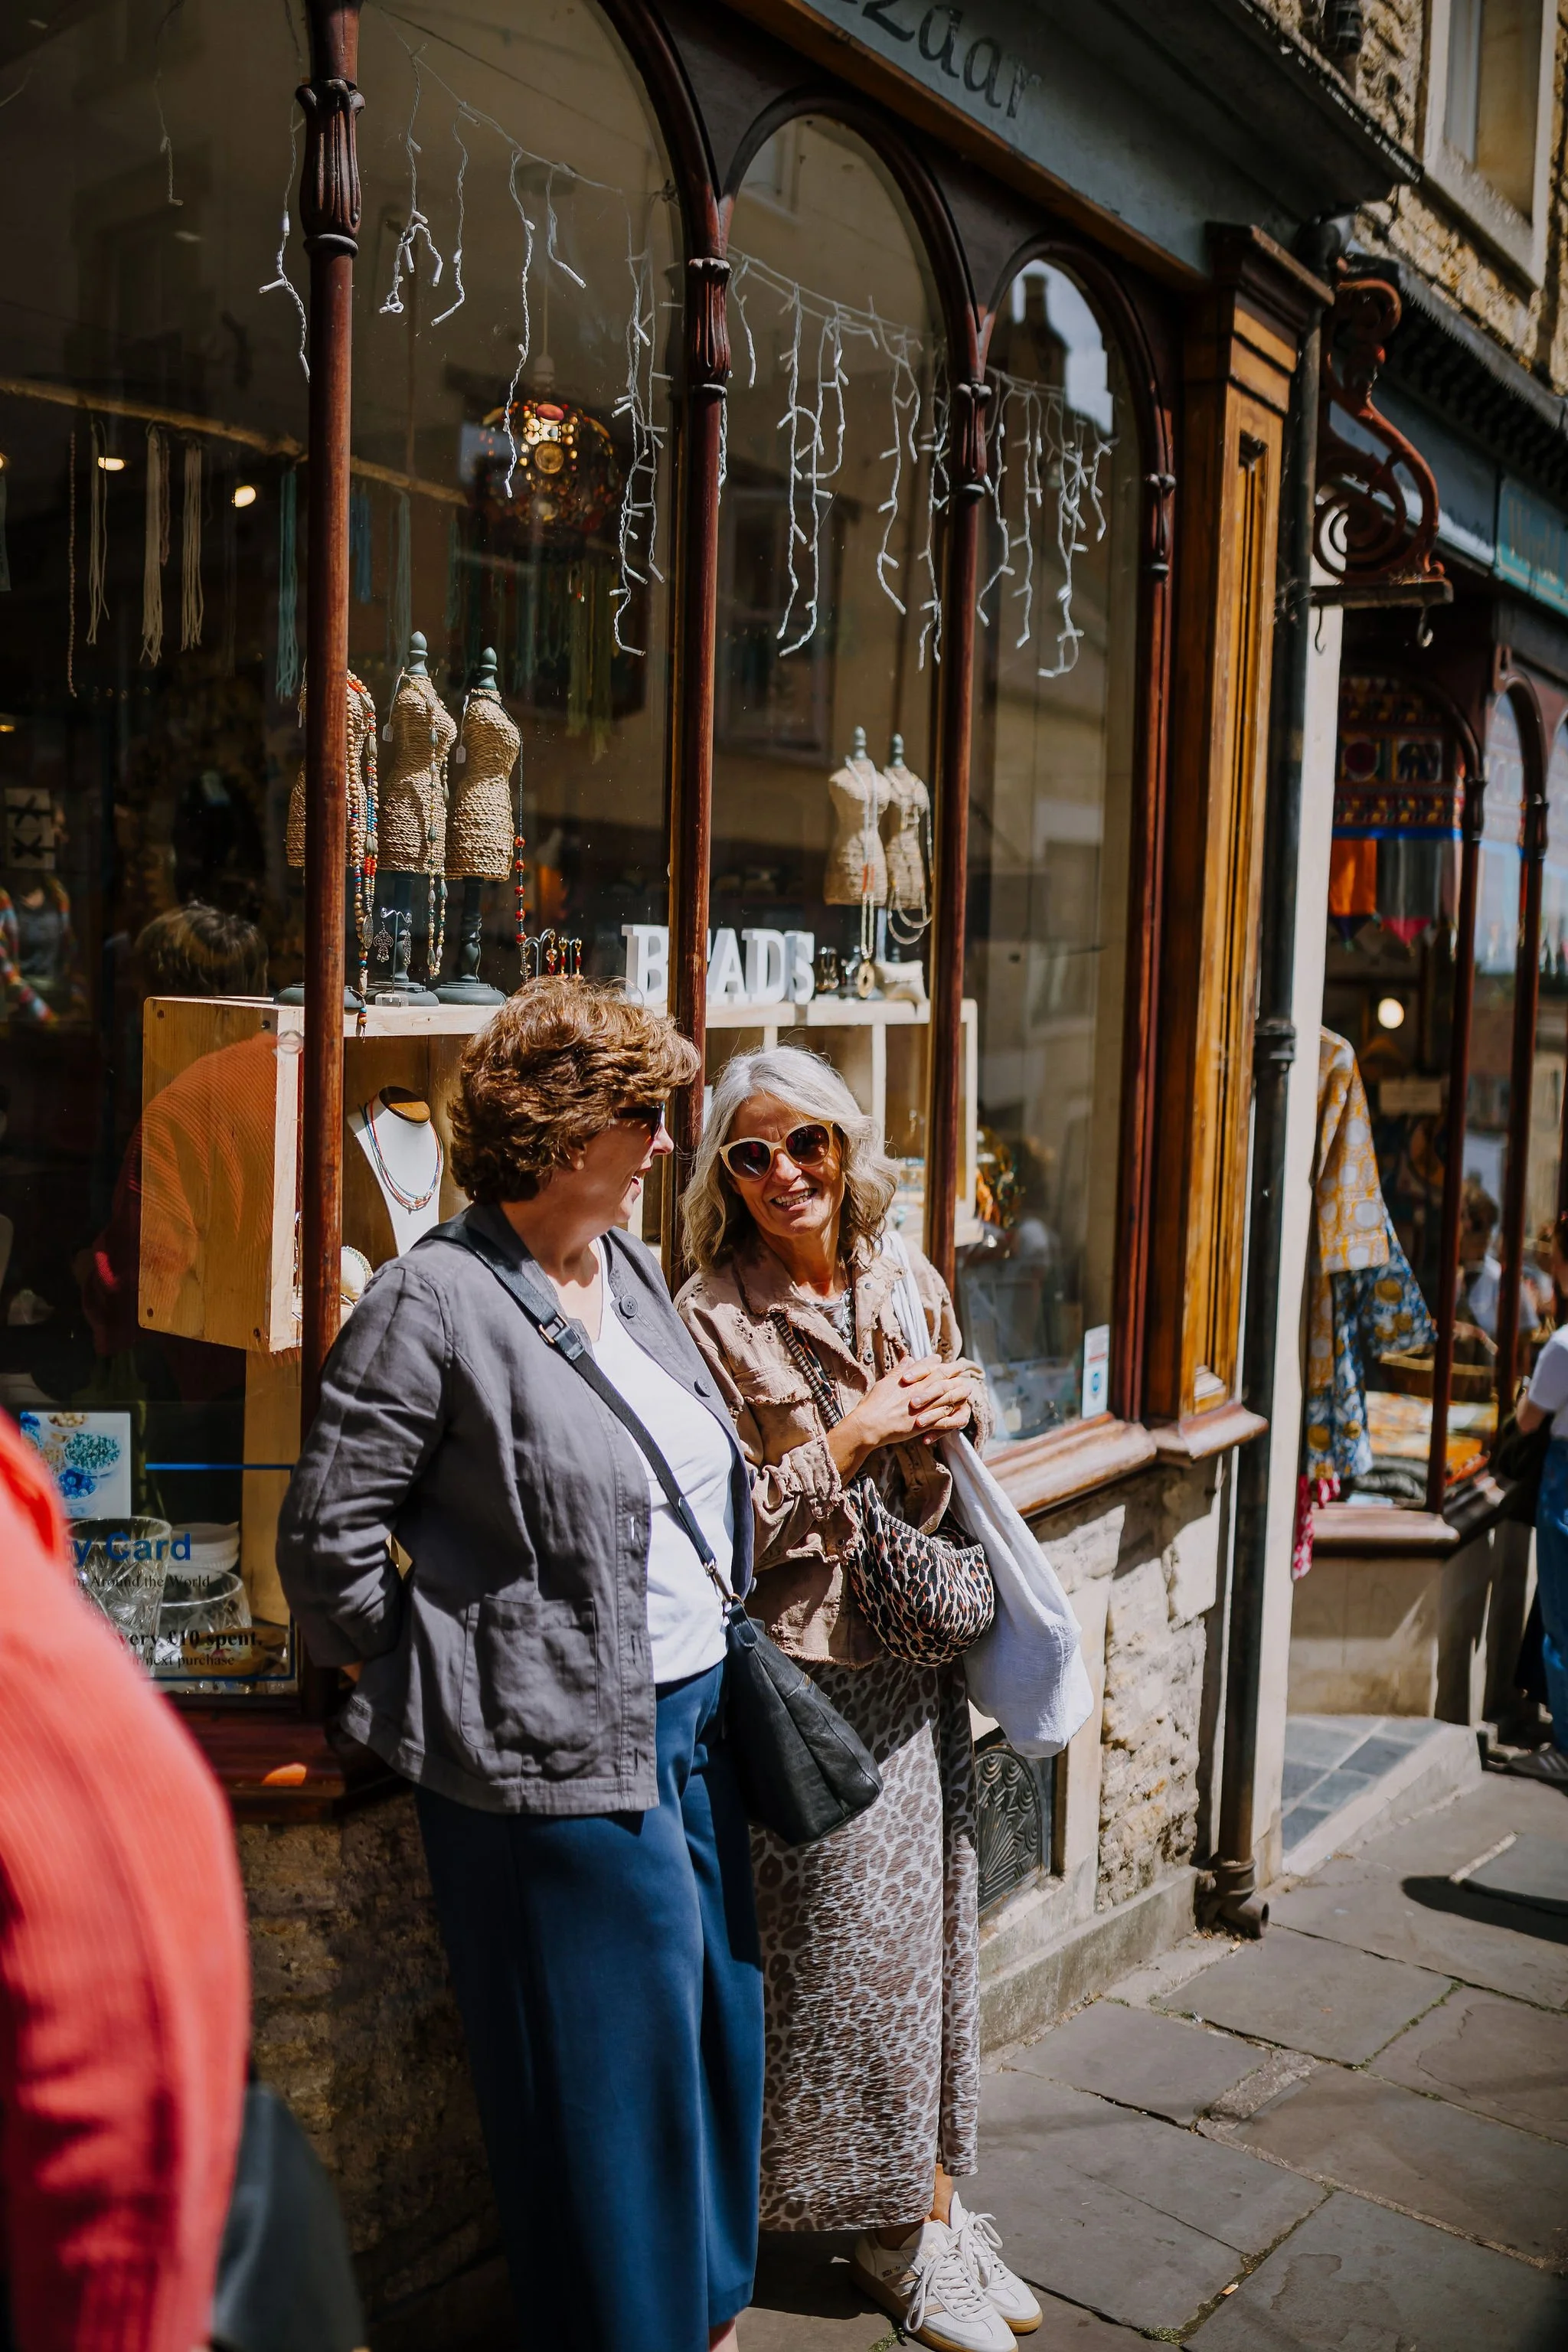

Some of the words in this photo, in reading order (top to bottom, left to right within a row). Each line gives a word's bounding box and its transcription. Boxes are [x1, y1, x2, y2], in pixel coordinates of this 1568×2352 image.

[841, 0, 1043, 118] zaar
[621, 923, 815, 1005] BADS
[106, 1532, 191, 1561] Card
[91, 1575, 139, 1588] Around
[145, 1575, 164, 1588] the
[167, 1575, 210, 1588] World
[117, 1634, 159, 1650] very
[207, 1631, 263, 1650] spent.
[146, 1655, 173, 1667] next
[178, 1652, 234, 1669] purchase
